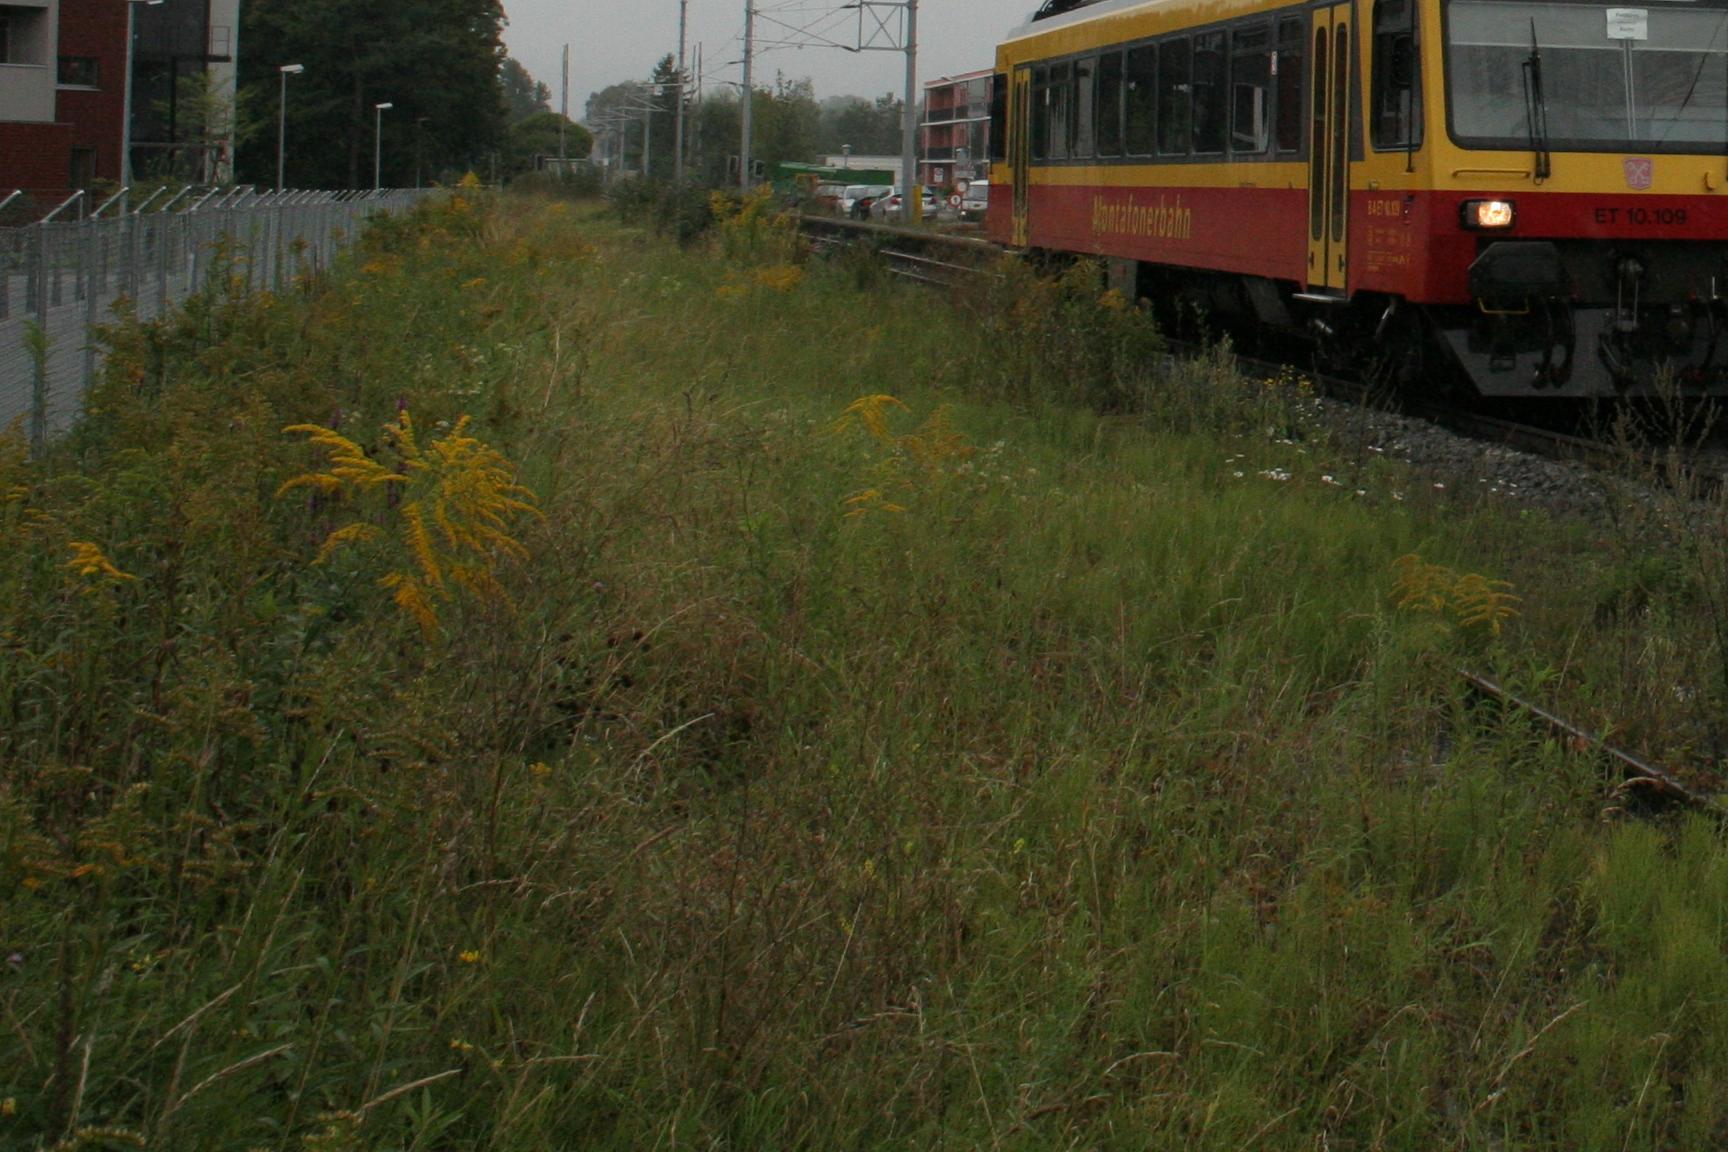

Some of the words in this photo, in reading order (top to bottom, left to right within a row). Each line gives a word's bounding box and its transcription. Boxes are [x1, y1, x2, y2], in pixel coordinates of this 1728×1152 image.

[1092, 192, 1191, 241] Montafonerbahn
[1595, 208, 1618, 224] ET
[1627, 208, 1687, 225] 10.109
